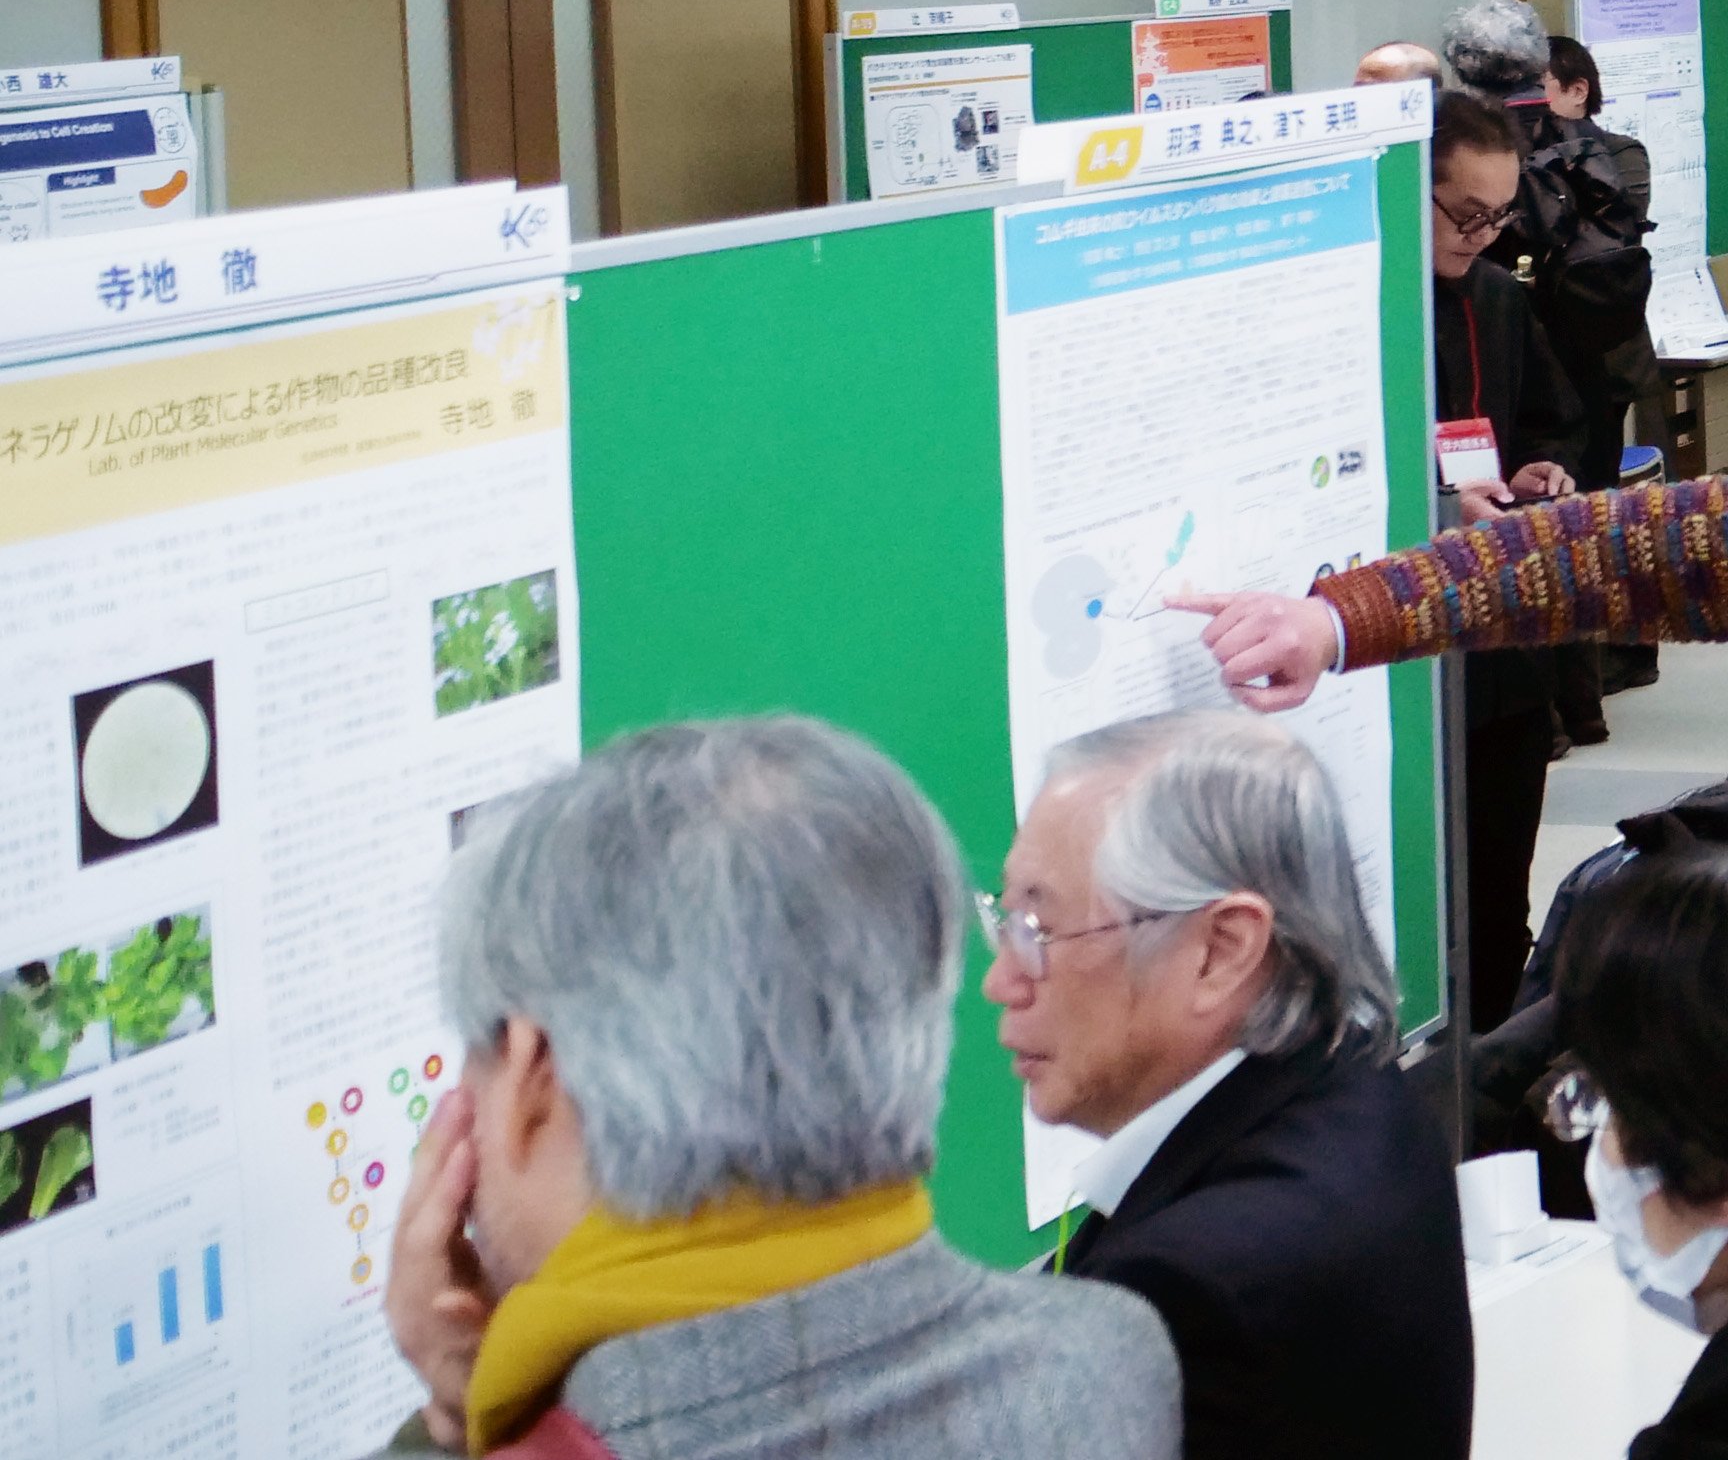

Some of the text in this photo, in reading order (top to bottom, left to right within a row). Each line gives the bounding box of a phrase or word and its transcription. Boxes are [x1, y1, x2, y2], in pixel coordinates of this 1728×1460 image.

[0, 75, 22, 92] 西
[1325, 101, 1359, 134] 英明
[1088, 140, 1129, 171] A-4
[96, 248, 259, 312] 寺地 徹
[440, 387, 539, 435] 寺地 徹
[88, 412, 340, 477] Lab. of Plant Molecular Genetics
